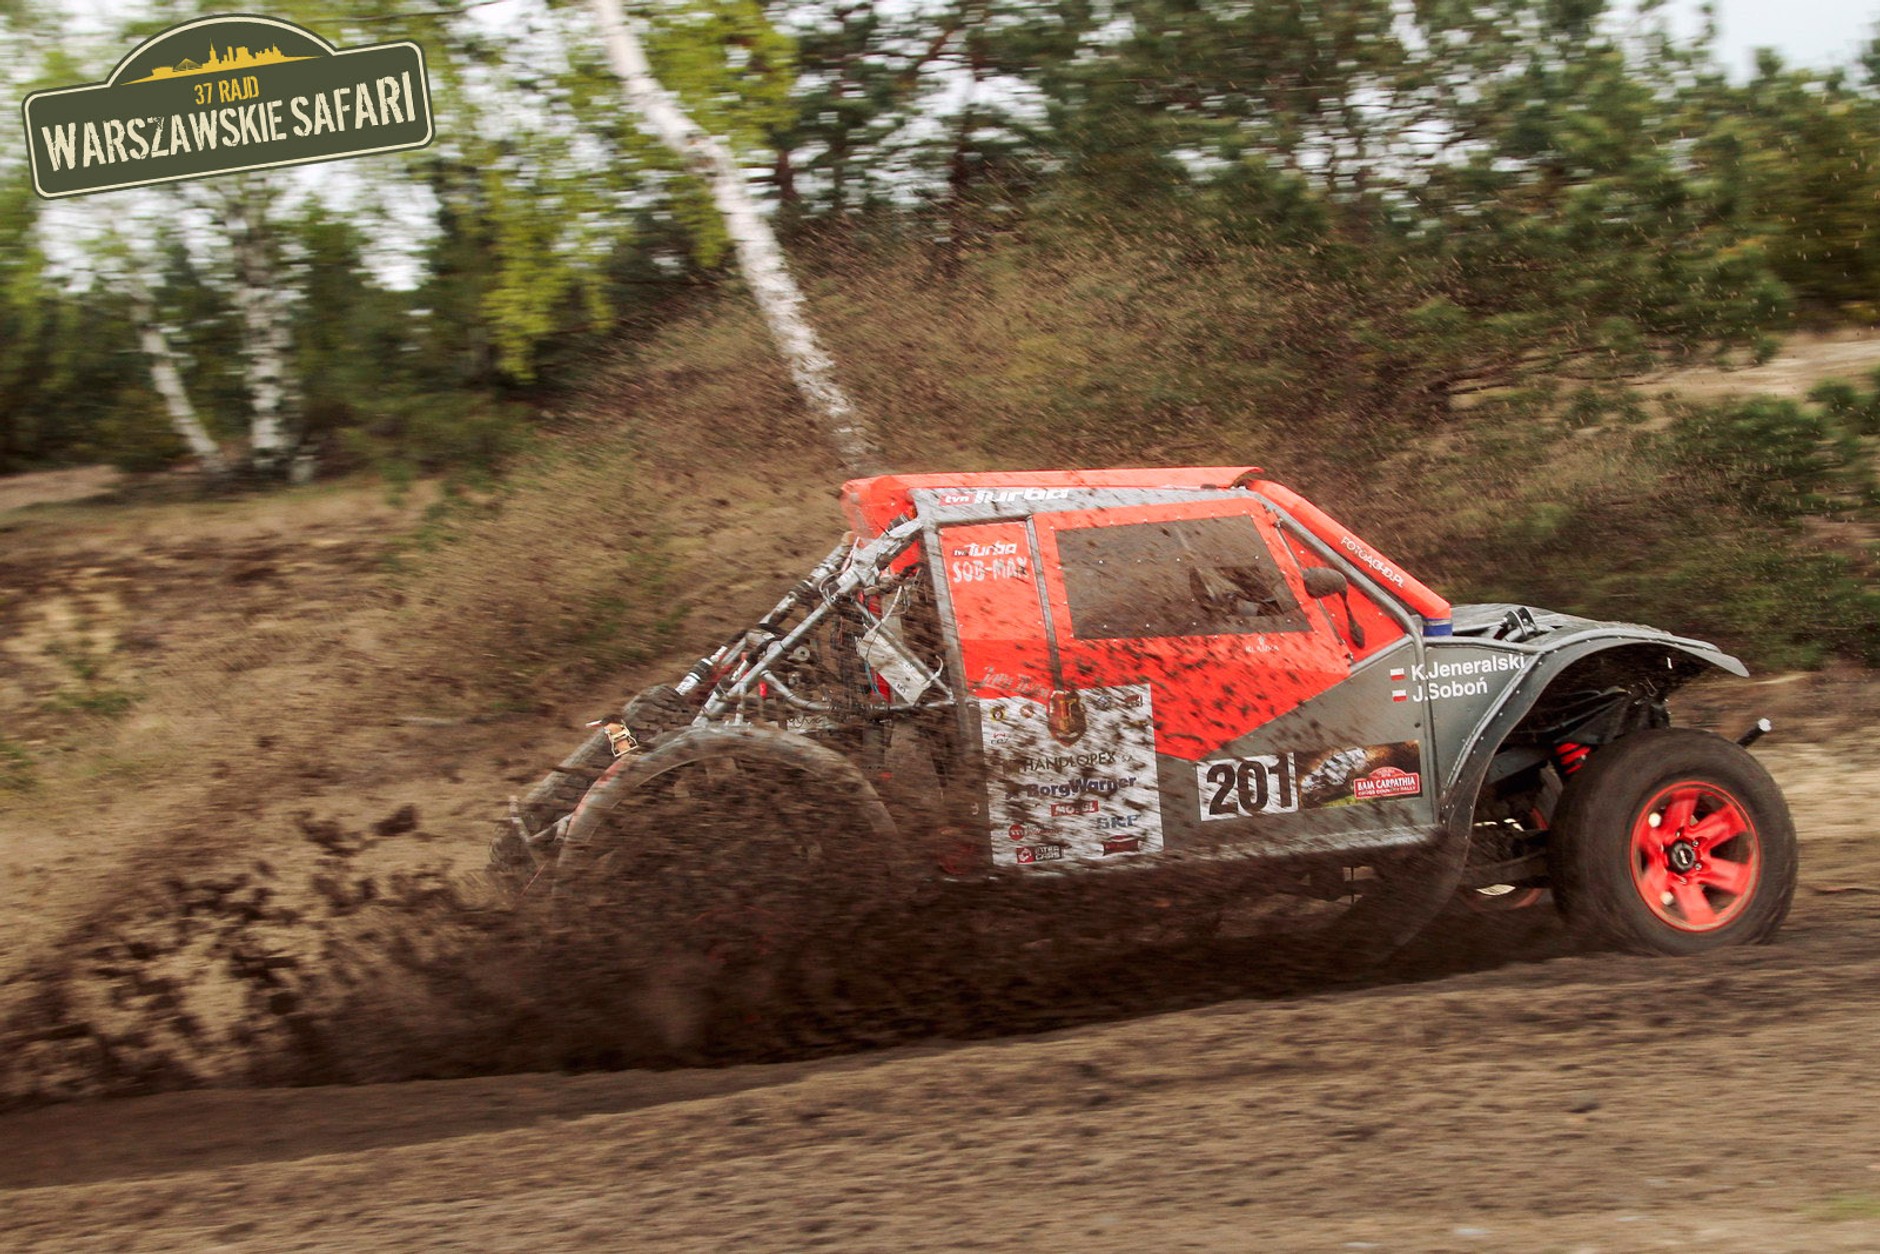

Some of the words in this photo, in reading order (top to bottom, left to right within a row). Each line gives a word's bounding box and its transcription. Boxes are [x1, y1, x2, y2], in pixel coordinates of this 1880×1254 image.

[964, 541, 1017, 557] Turbo
[1411, 653, 1526, 681] K.Jeneralski
[1412, 677, 1488, 702] J.Soboń
[1023, 751, 1116, 772] HANDLOPEX
[1026, 777, 1137, 797] BorgWarner
[1206, 752, 1293, 815] 201
[1376, 777, 1415, 788] CARPATHIA
